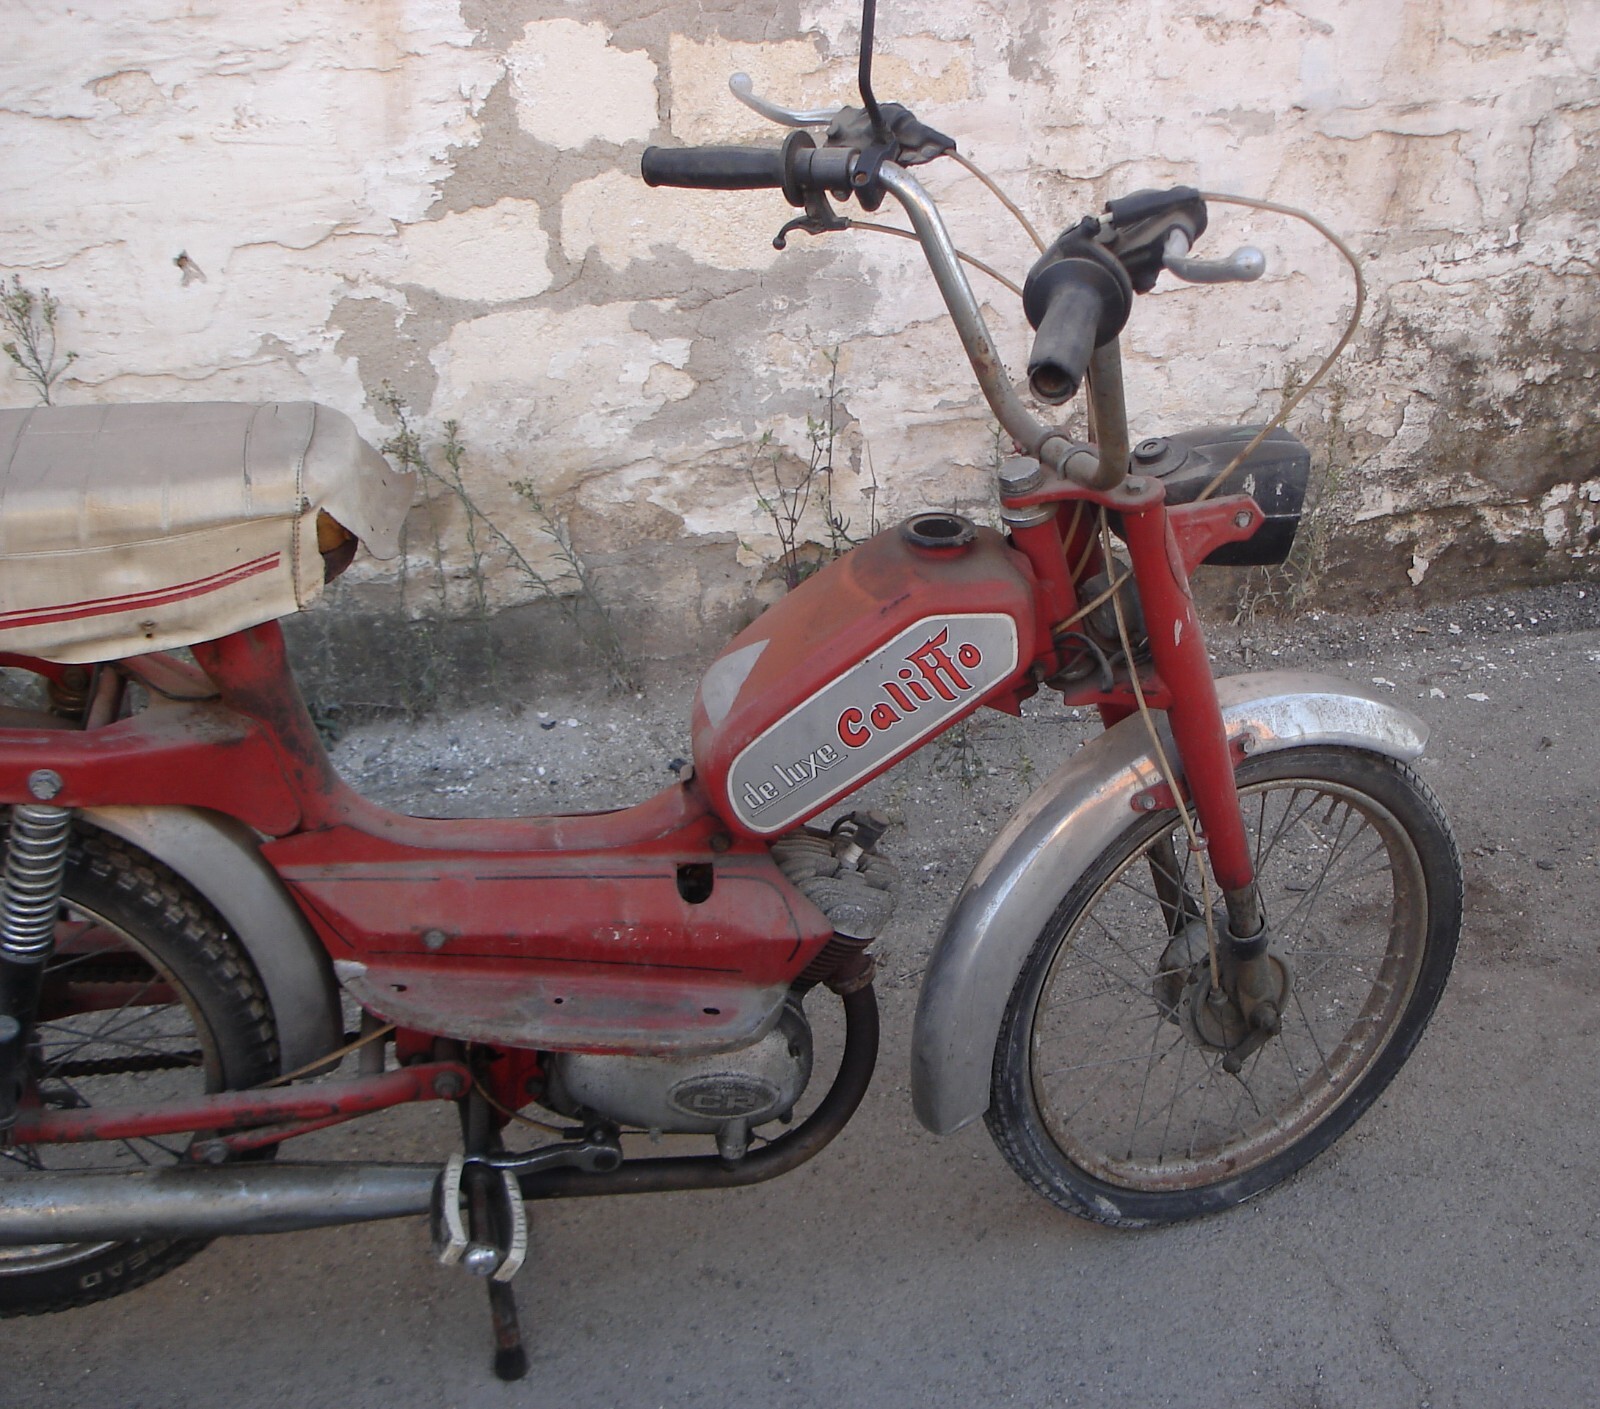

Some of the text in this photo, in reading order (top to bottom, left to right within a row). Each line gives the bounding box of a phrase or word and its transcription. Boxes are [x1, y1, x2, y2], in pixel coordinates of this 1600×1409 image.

[743, 625, 982, 810] de luxe Califfo
